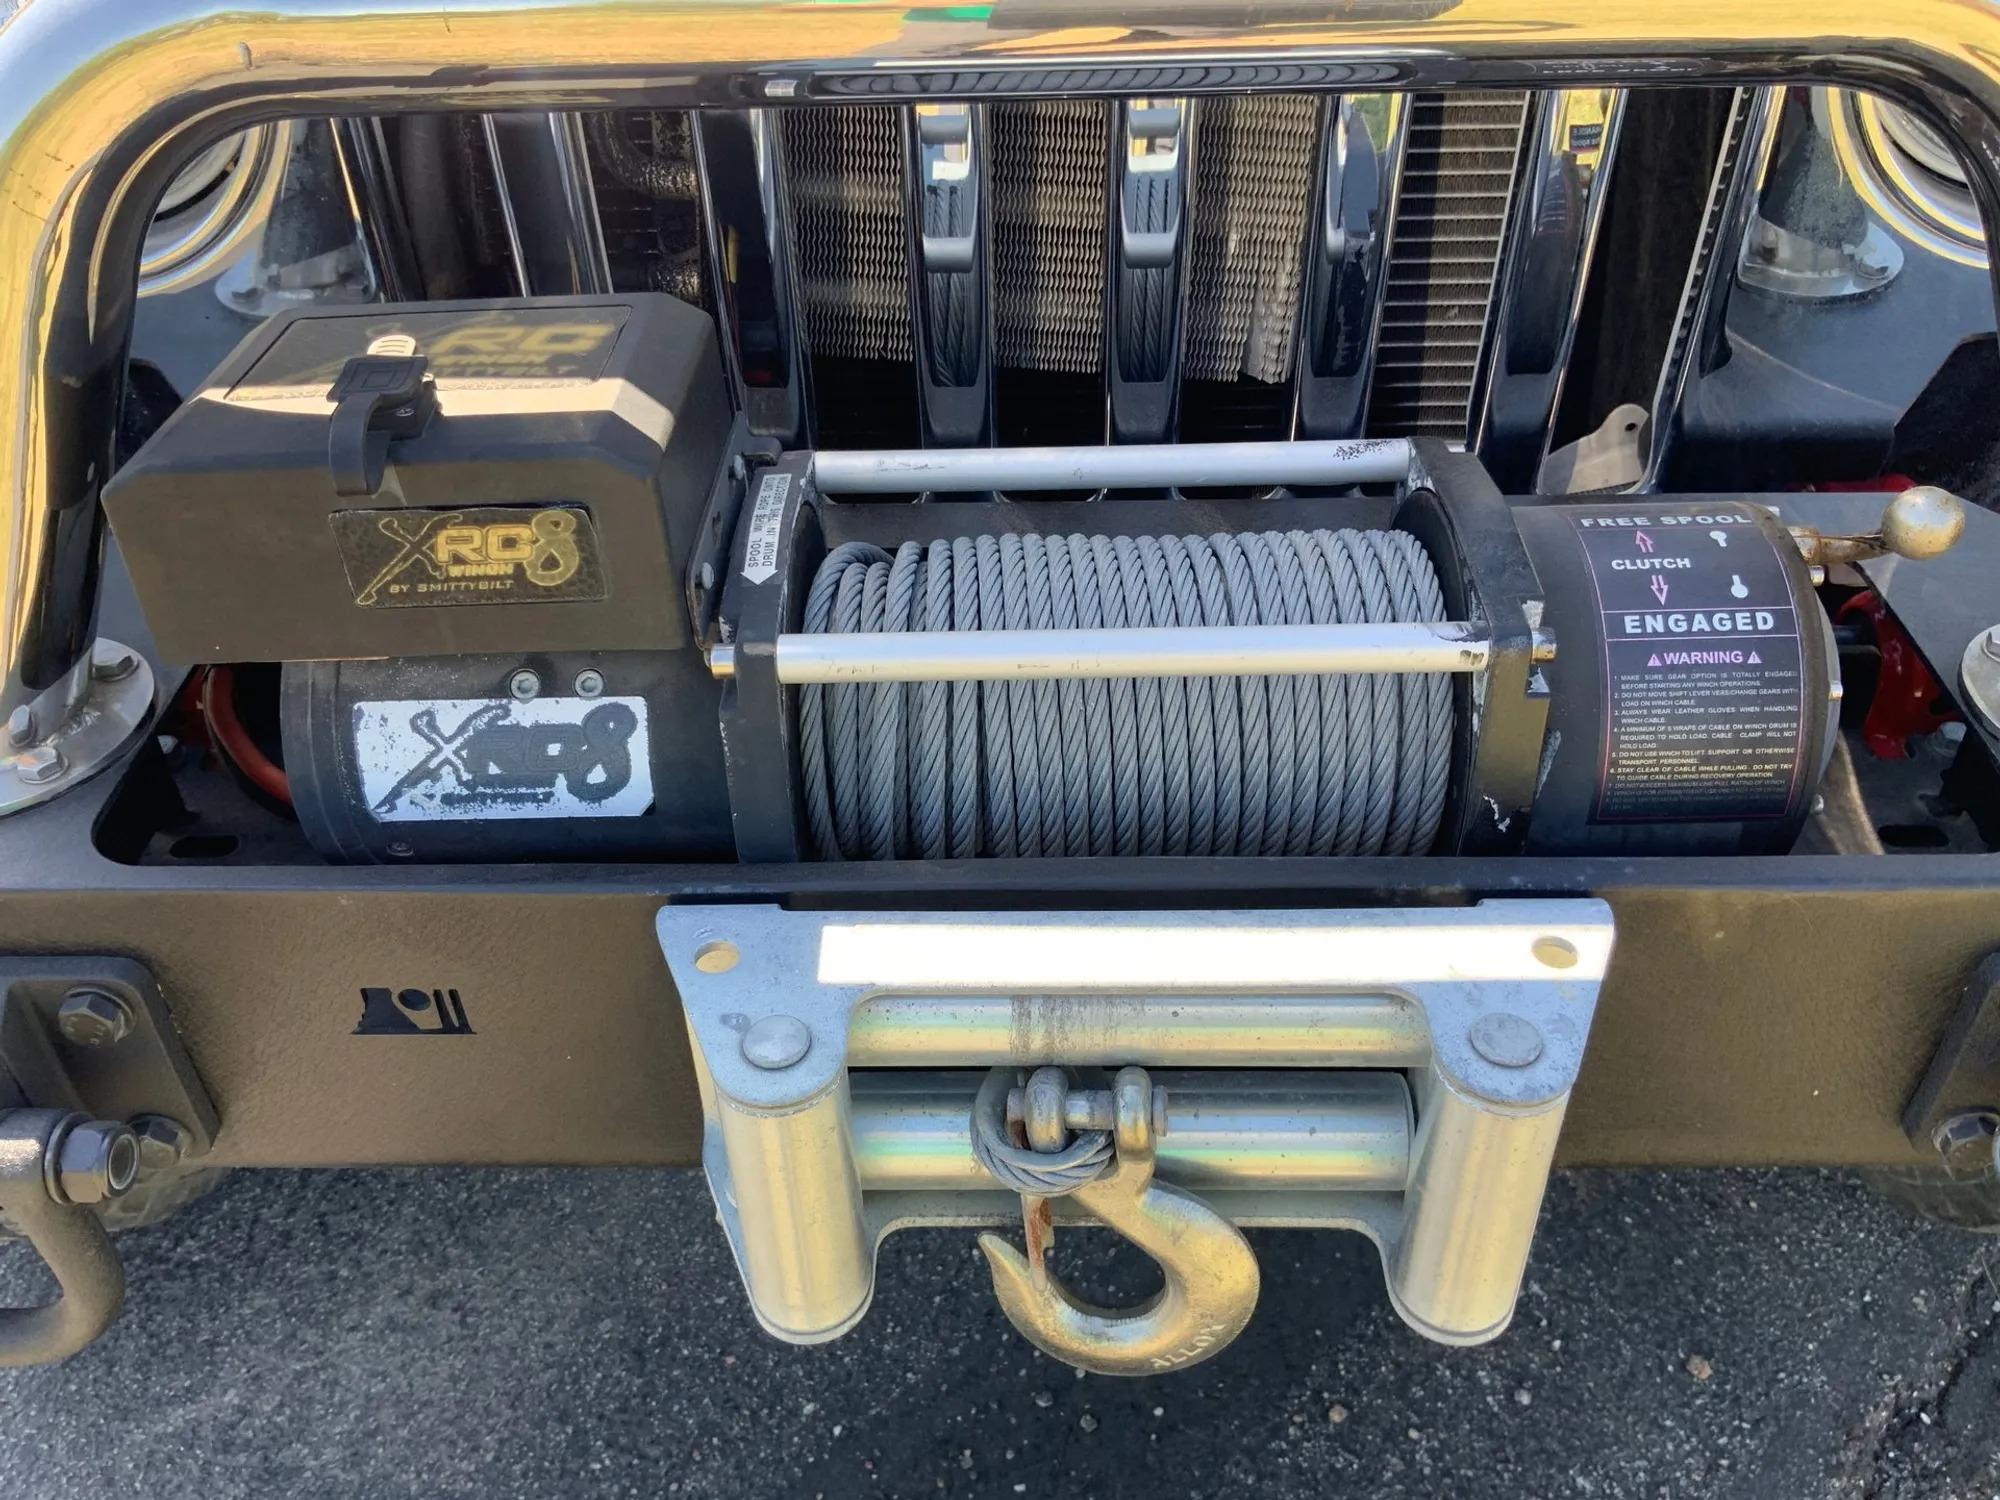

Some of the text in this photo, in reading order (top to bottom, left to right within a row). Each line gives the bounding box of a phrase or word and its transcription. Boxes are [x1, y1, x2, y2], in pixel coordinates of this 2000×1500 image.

[1580, 514, 1752, 528] FREE SPOOL
[766, 527, 776, 536] IN
[748, 538, 762, 568] SPOOL
[762, 541, 776, 567] DRUM
[1611, 557, 1691, 571] CLUTCH
[389, 580, 514, 594] BY SMITTYBILT
[1623, 611, 1774, 634] ENGAGED
[1664, 651, 1743, 665] WARNING
[1150, 1324, 1226, 1368] ALLOY
